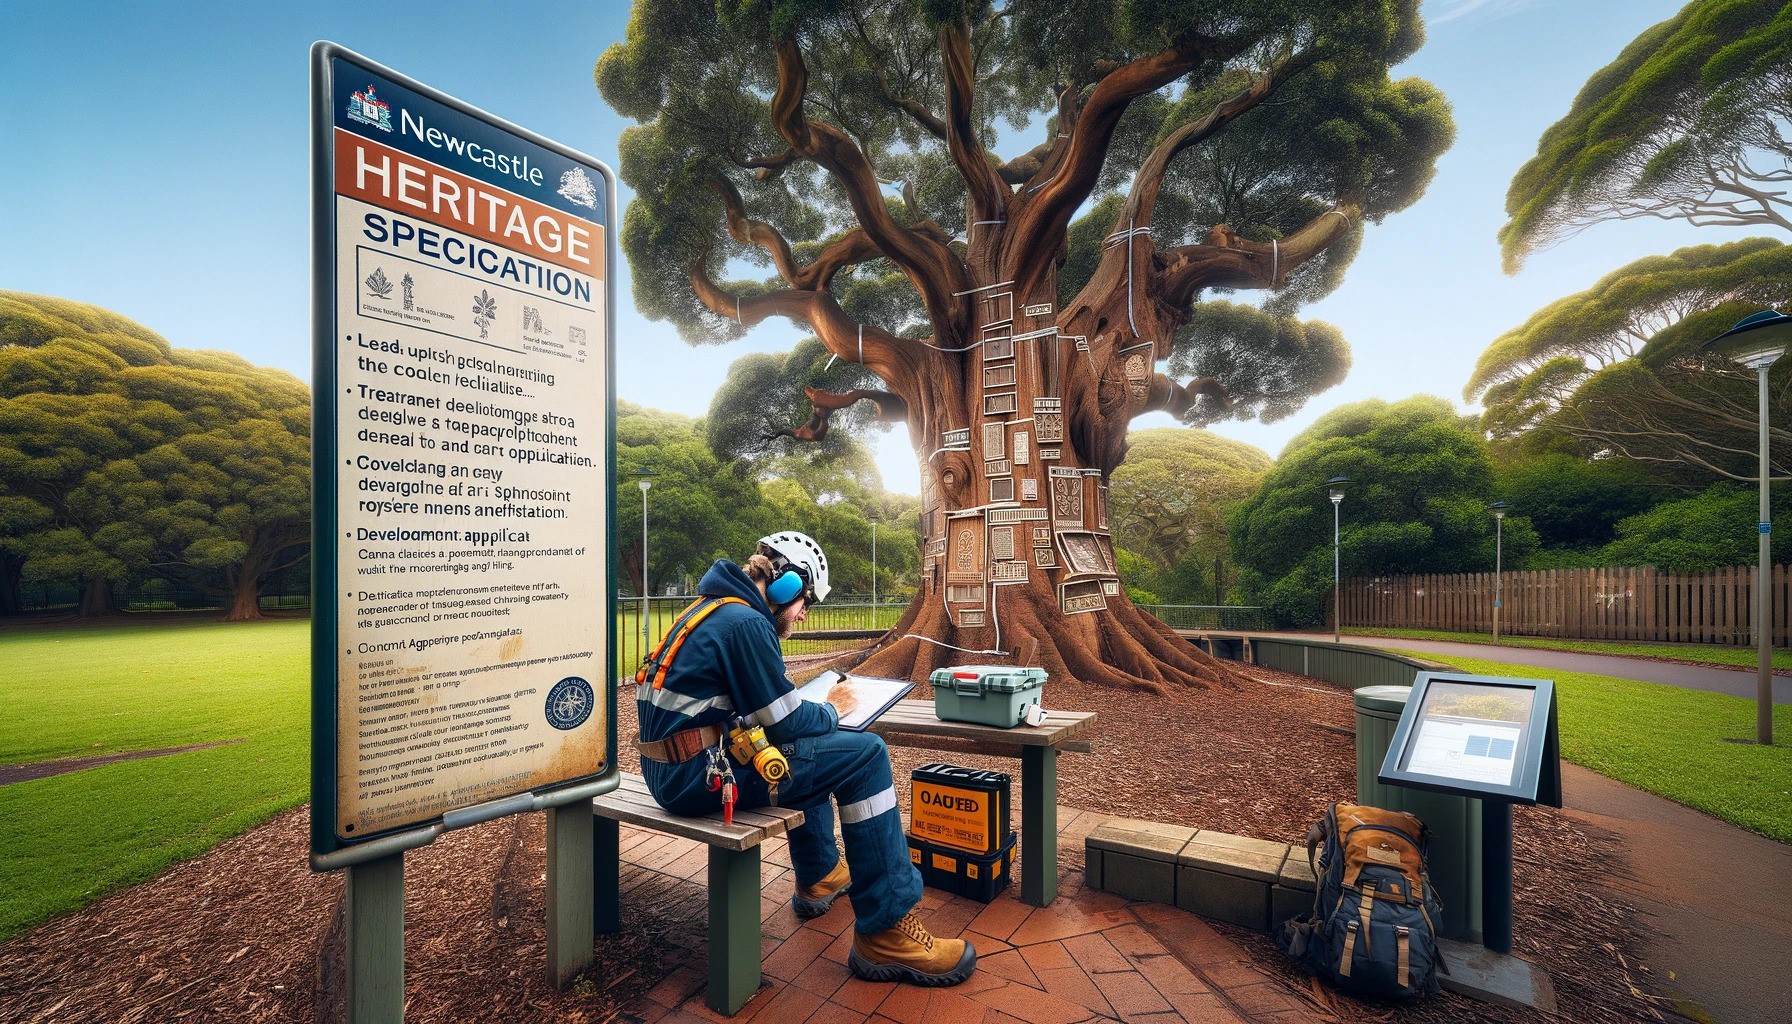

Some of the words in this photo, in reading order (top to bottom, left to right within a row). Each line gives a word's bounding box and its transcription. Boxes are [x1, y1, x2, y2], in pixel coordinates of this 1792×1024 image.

[400, 108, 544, 187] Newcastle
[356, 146, 590, 264] HERITAGE
[358, 356, 388, 374] the
[419, 433, 435, 449] to
[441, 440, 469, 453] and
[451, 465, 469, 477] an
[575, 547, 586, 556] of
